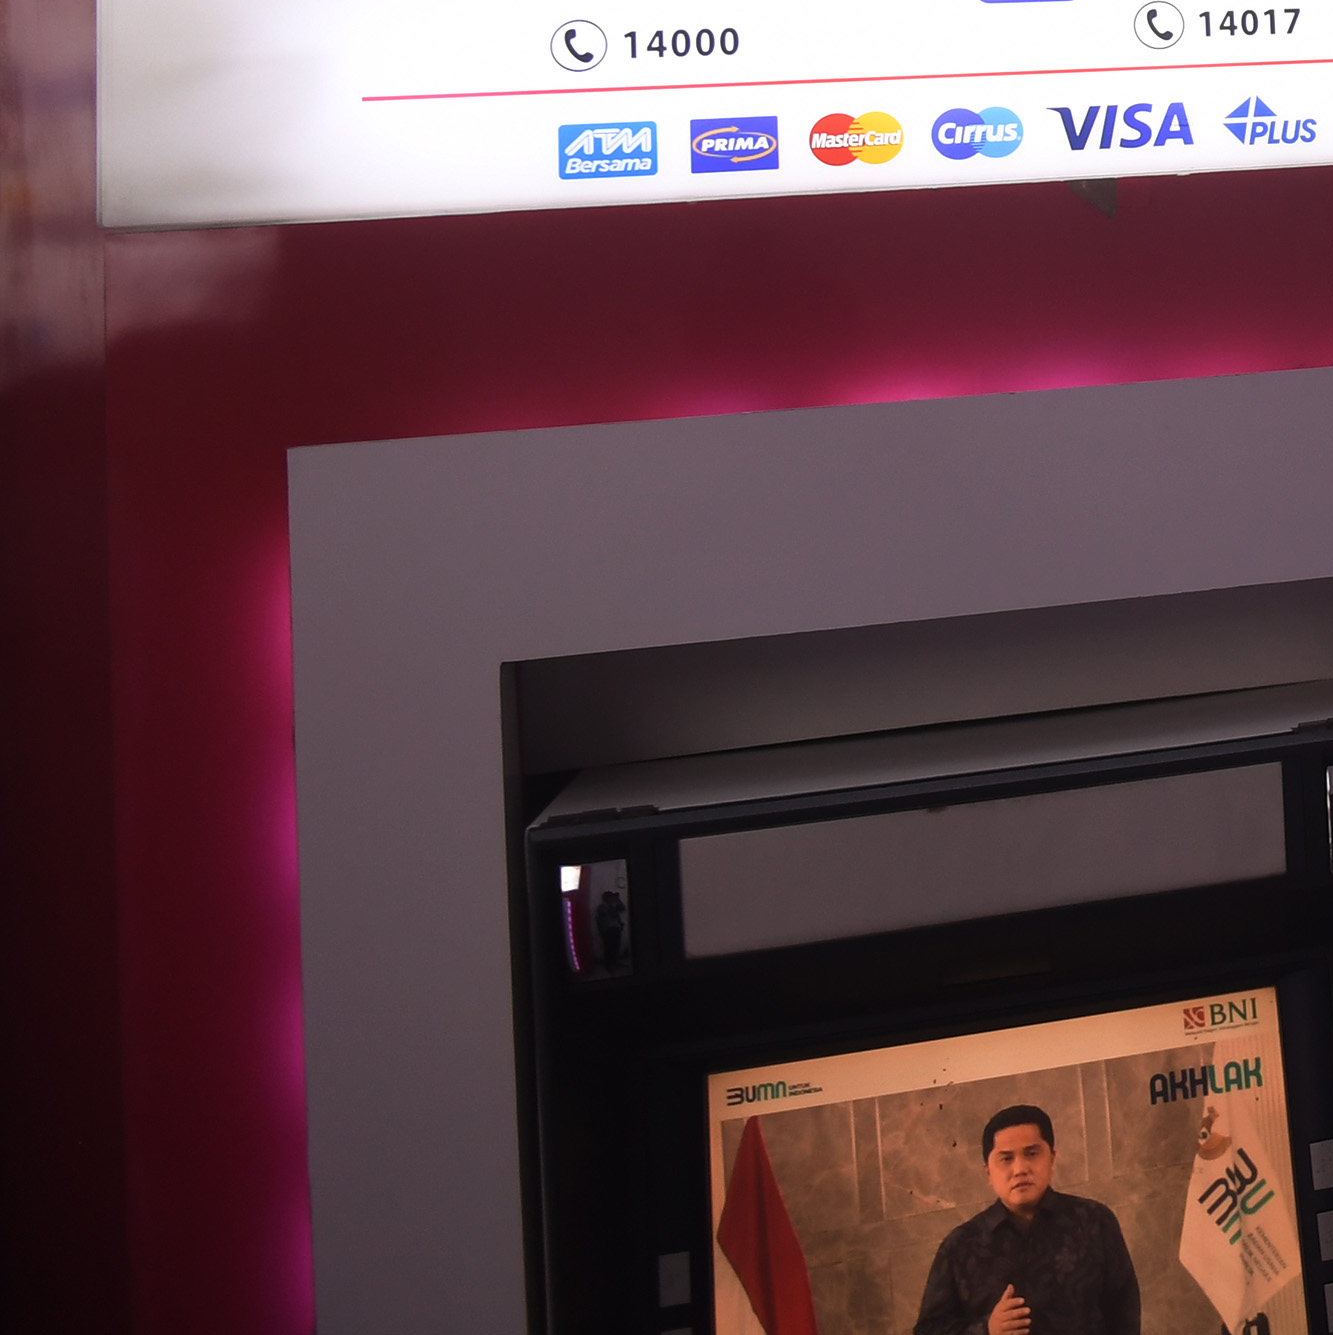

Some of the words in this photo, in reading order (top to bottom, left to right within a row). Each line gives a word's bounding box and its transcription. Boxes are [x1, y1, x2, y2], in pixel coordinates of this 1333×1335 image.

[1199, 8, 1300, 38] 14017
[624, 27, 740, 59] 14000
[811, 129, 903, 150] MasterCard
[937, 121, 1022, 145] Cirrus
[1046, 102, 1194, 151] VISA
[1249, 118, 1317, 146] PLUS
[564, 127, 652, 156] ATM
[701, 135, 770, 153] PRIMA
[565, 157, 652, 175] Bersama
[1210, 997, 1258, 1026] BNI
[1150, 1057, 1263, 1105] AKHLAK
